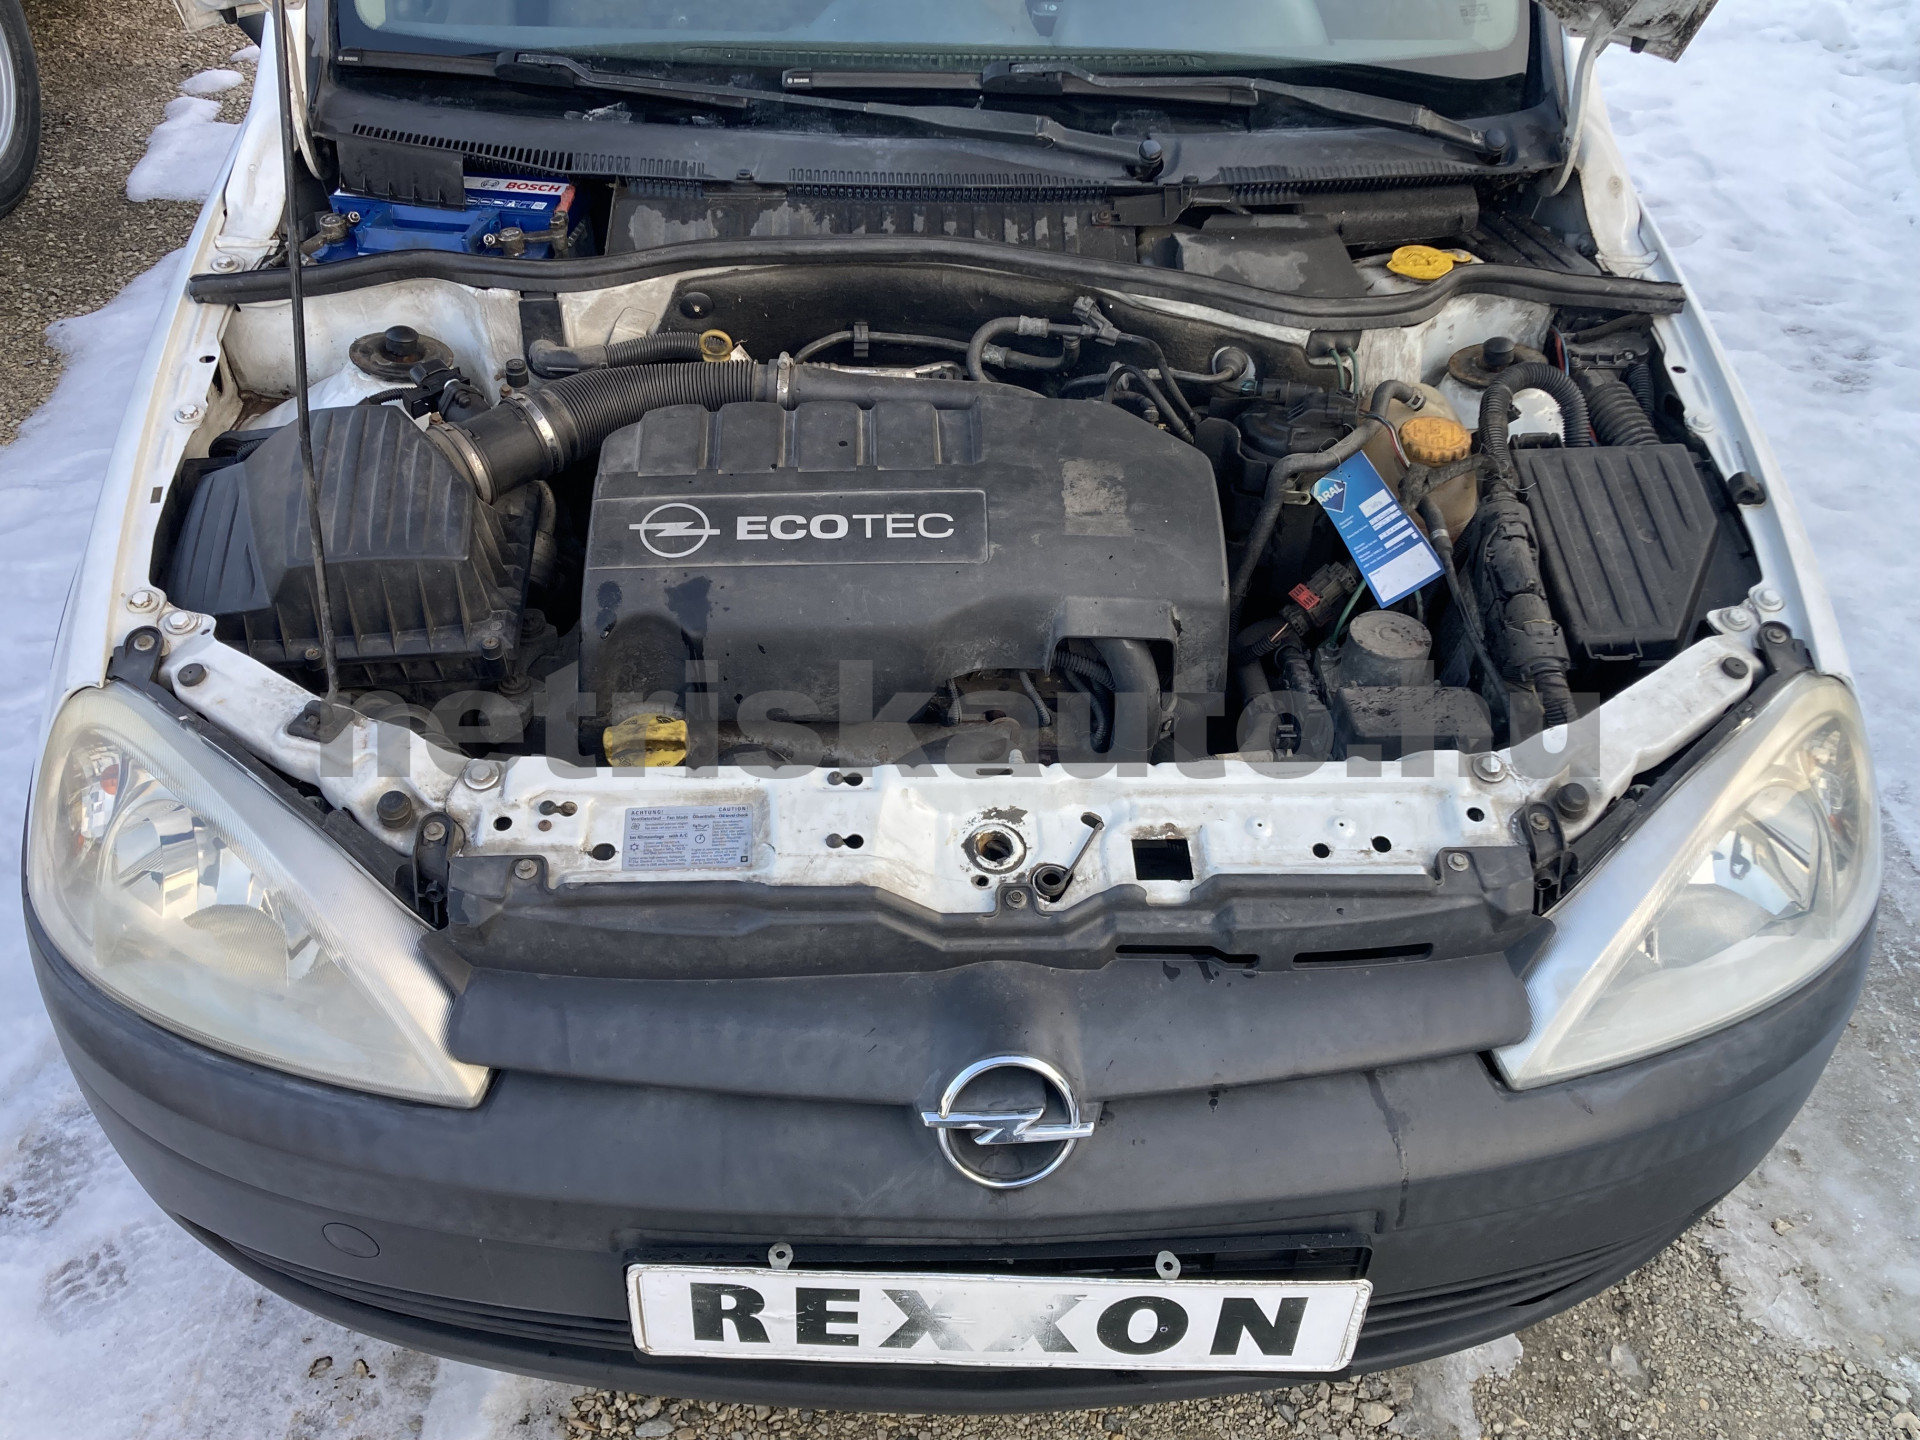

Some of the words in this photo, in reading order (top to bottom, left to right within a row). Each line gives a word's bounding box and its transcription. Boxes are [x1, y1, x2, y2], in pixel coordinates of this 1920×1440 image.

[504, 181, 562, 193] BOSCH
[1316, 483, 1344, 504] ARAL
[736, 512, 955, 540] ECOTEC
[689, 1282, 1309, 1357] REXXON
